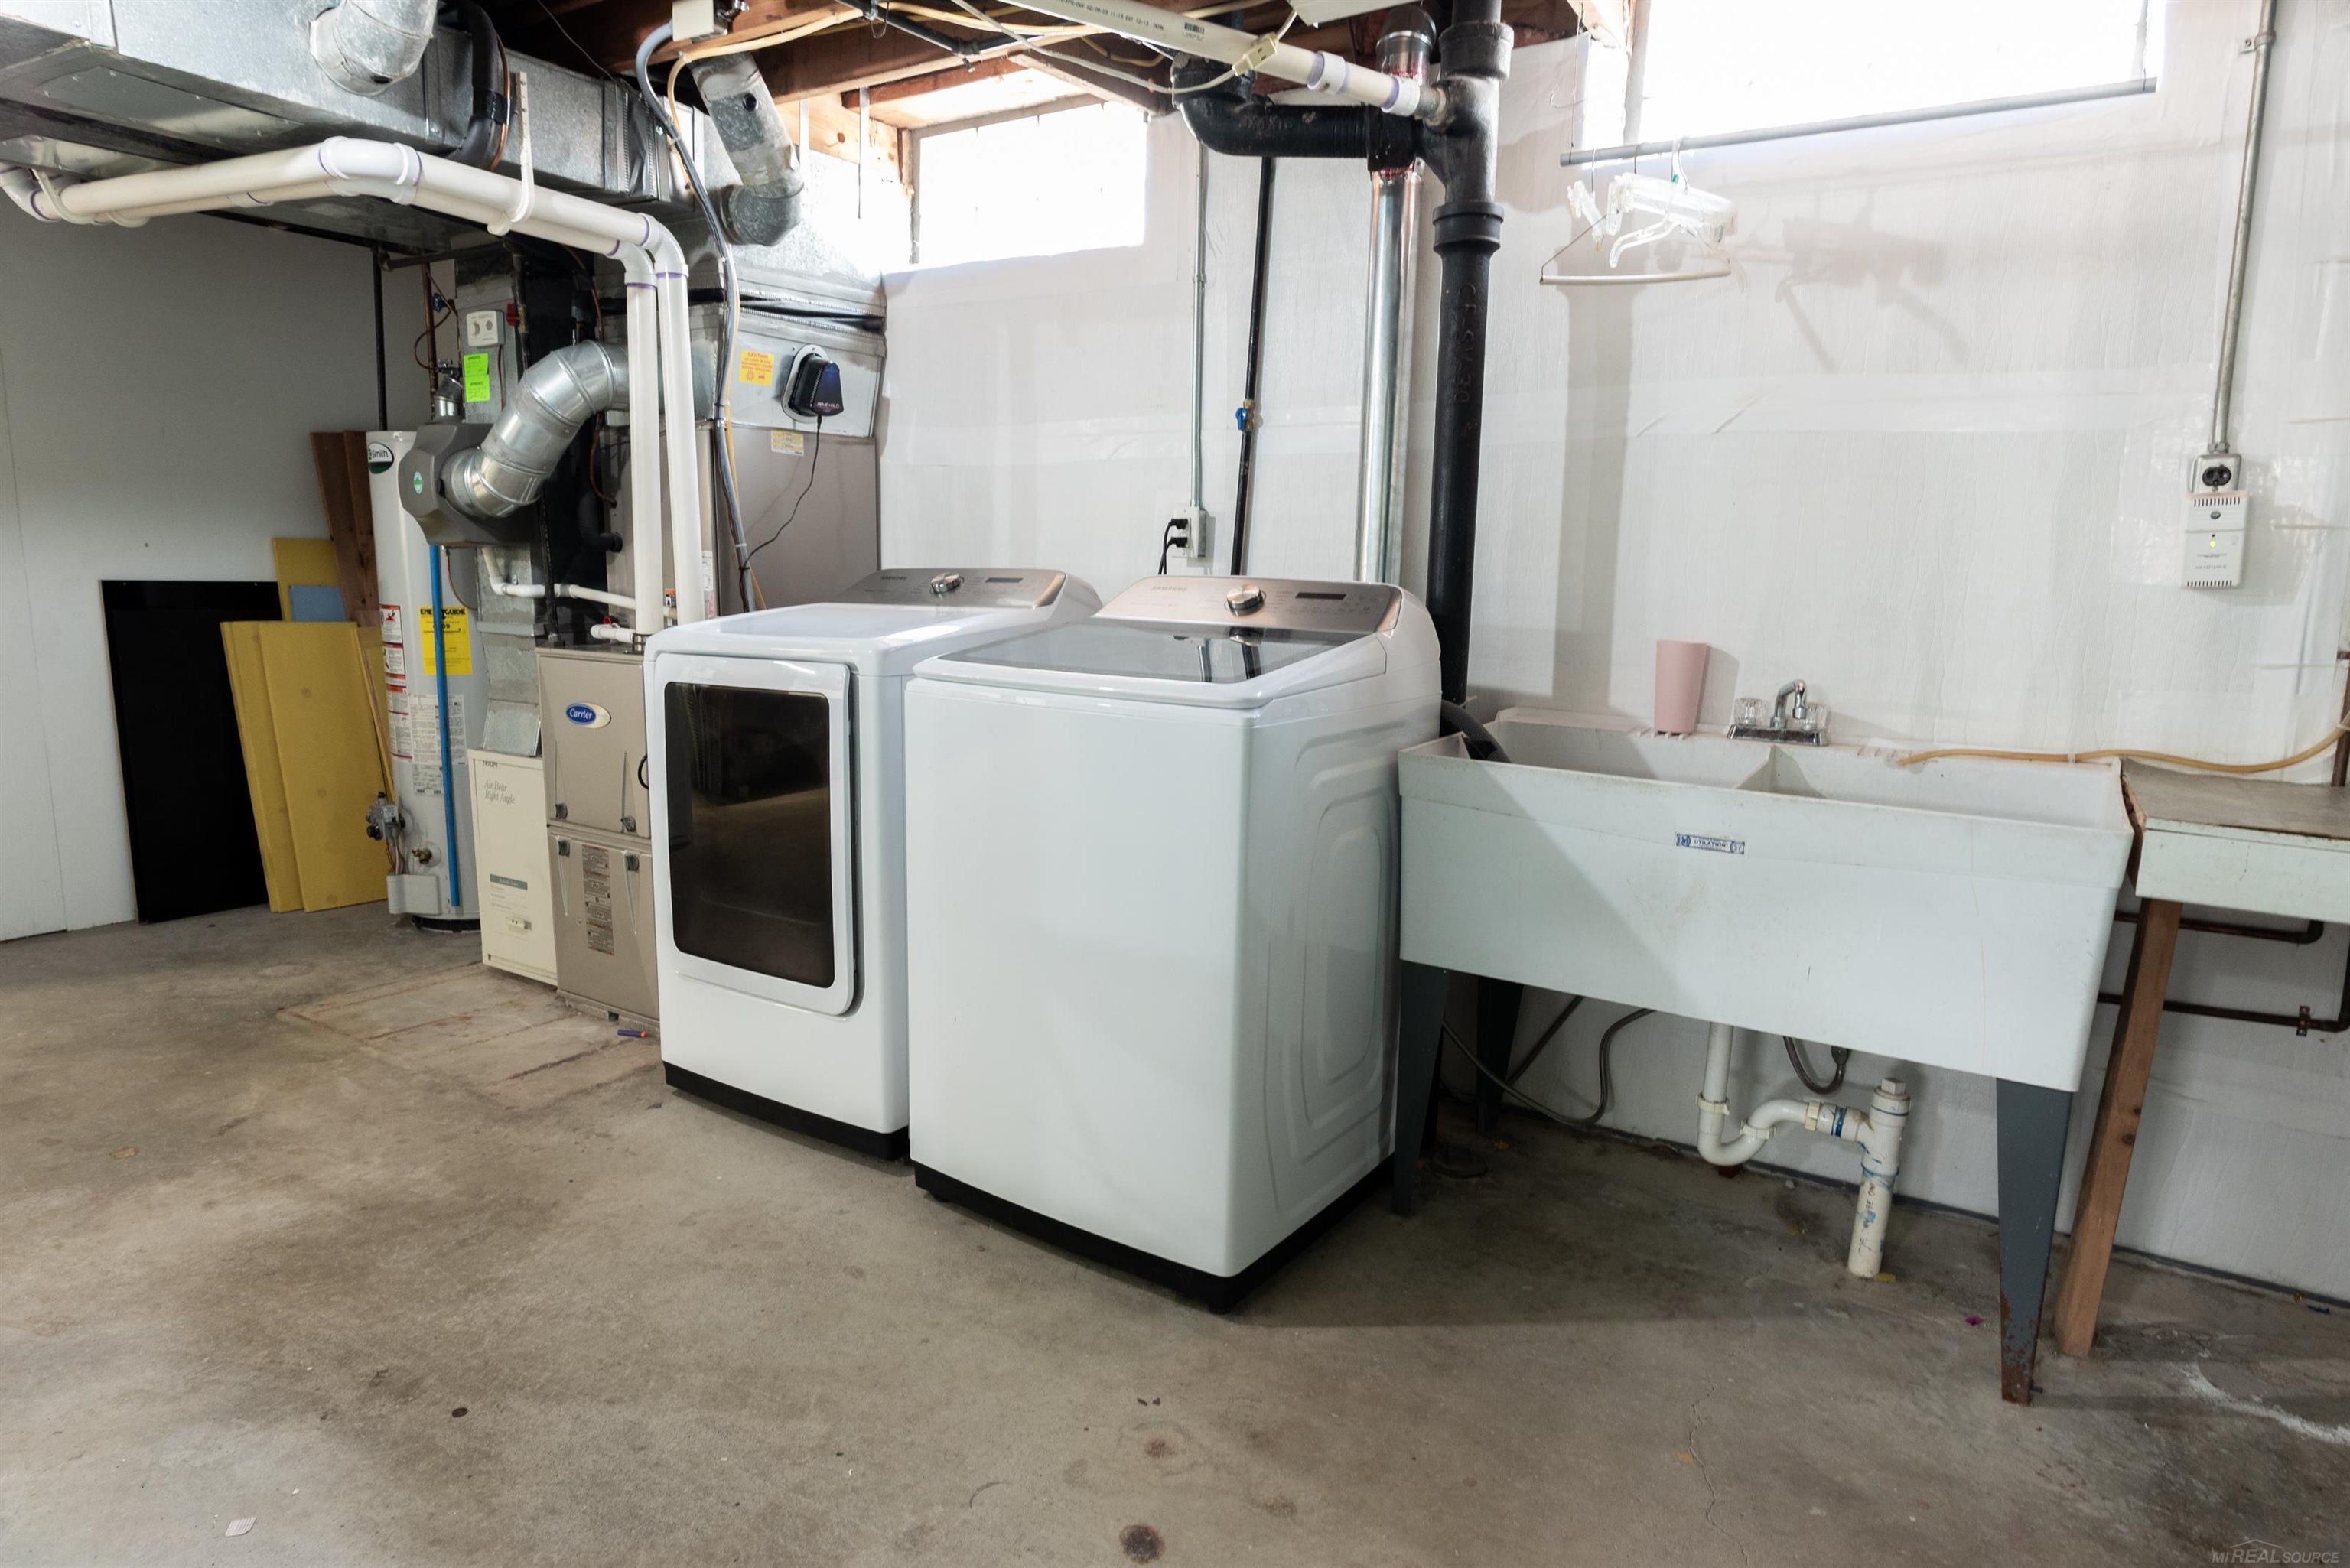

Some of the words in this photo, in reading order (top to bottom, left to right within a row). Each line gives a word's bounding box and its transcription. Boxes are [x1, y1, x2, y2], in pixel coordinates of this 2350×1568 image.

[372, 448, 389, 458] Smith
[569, 708, 593, 719] Carrier
[485, 790, 499, 802] Right
[500, 794, 516, 805] Angle
